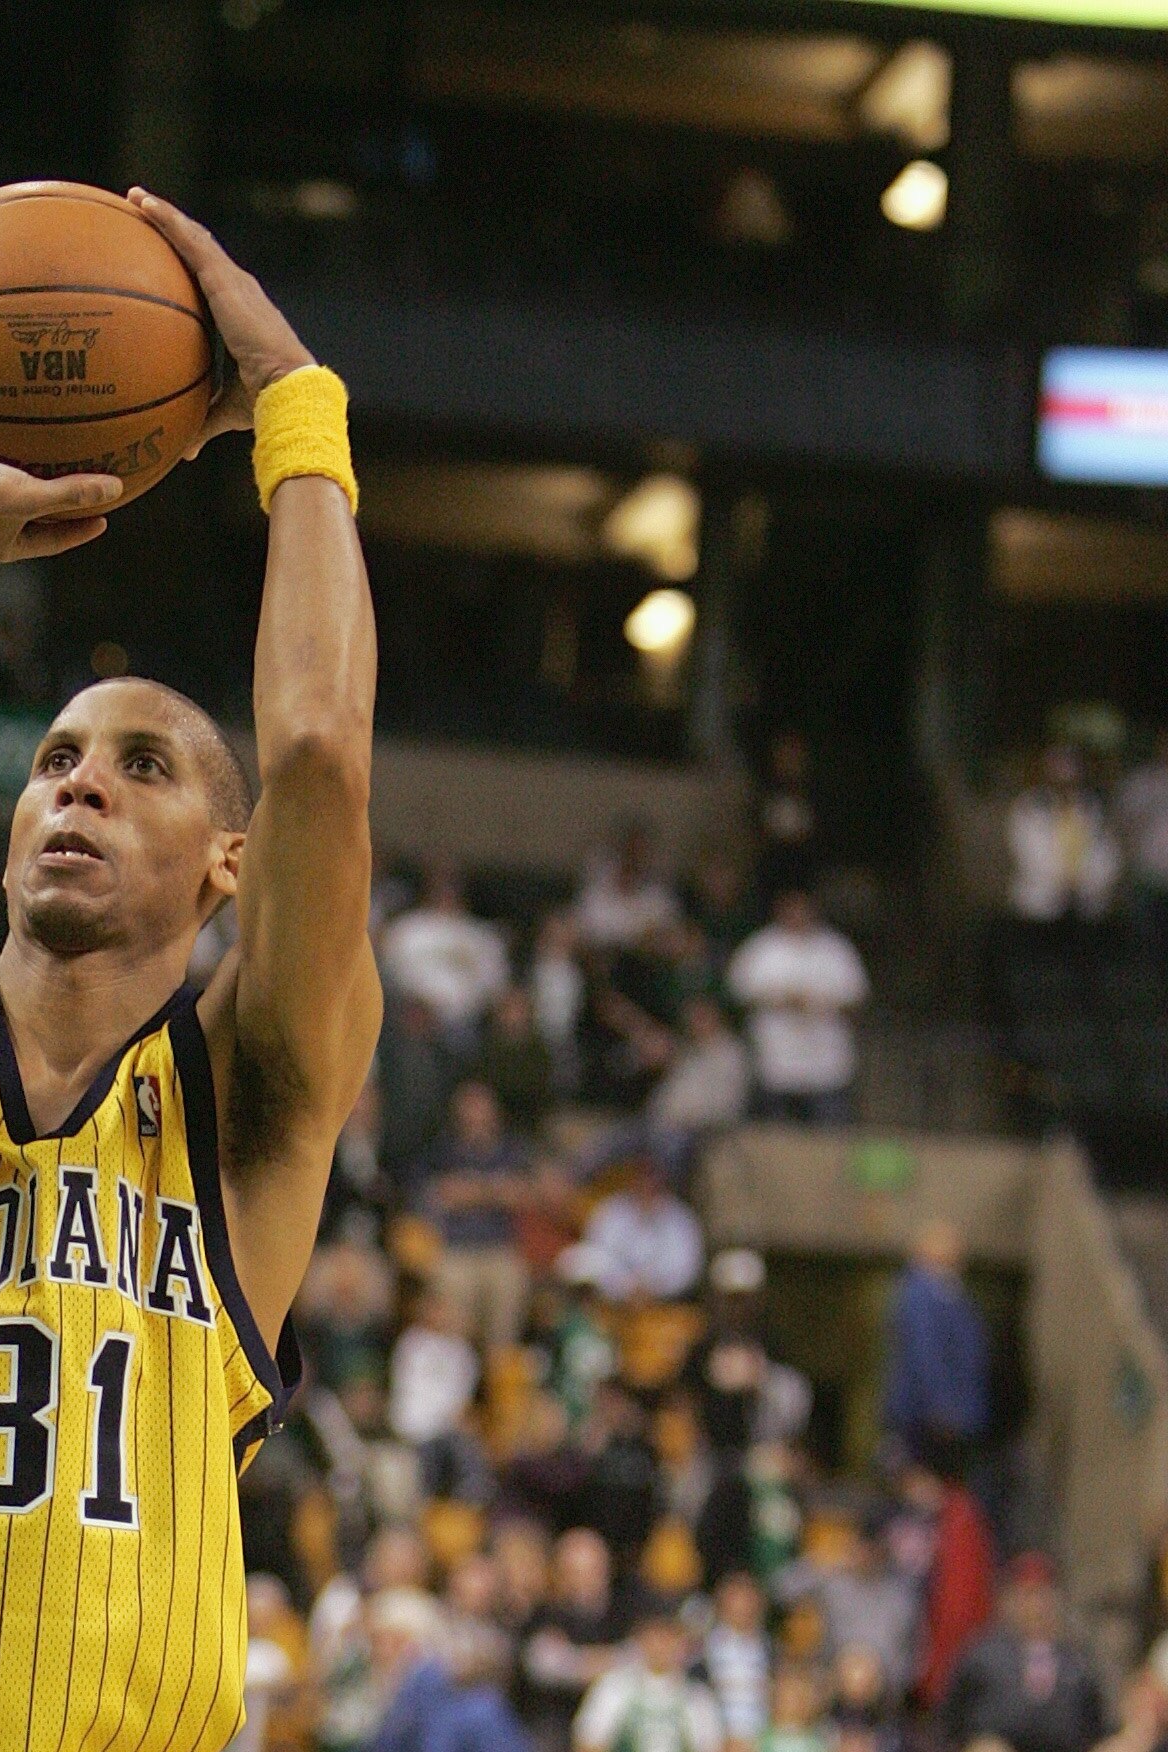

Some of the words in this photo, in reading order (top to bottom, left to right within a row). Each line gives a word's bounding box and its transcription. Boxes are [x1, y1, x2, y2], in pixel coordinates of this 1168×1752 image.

[20, 350, 87, 381] NBA
[22, 385, 62, 397] Game
[66, 384, 117, 397] Official
